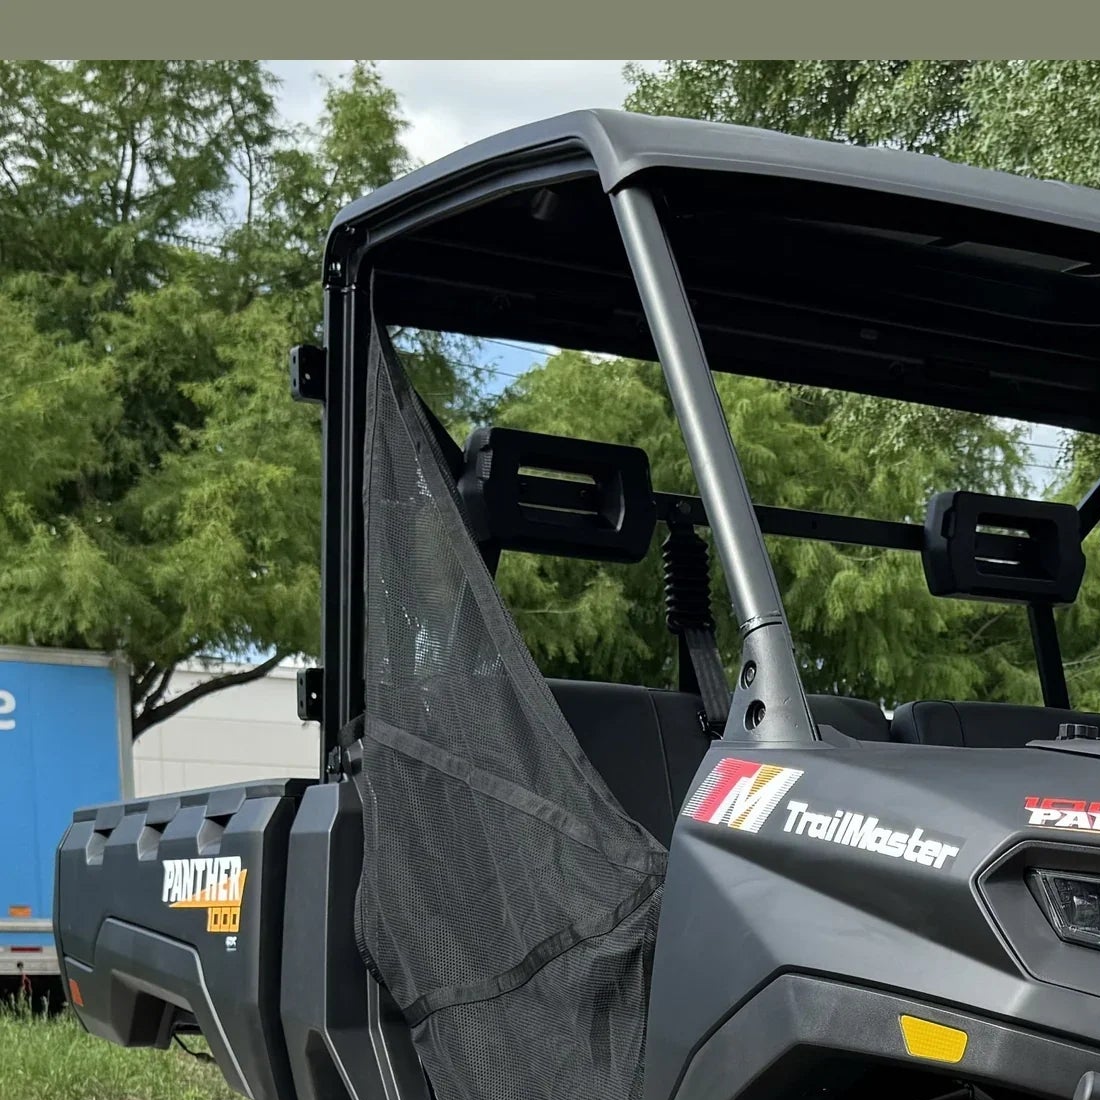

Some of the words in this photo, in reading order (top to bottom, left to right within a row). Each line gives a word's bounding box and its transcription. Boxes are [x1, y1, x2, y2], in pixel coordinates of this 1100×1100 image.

[783, 800, 960, 869] TrailMaster
[162, 856, 241, 902] PANTHER
[207, 906, 240, 932] 1000
